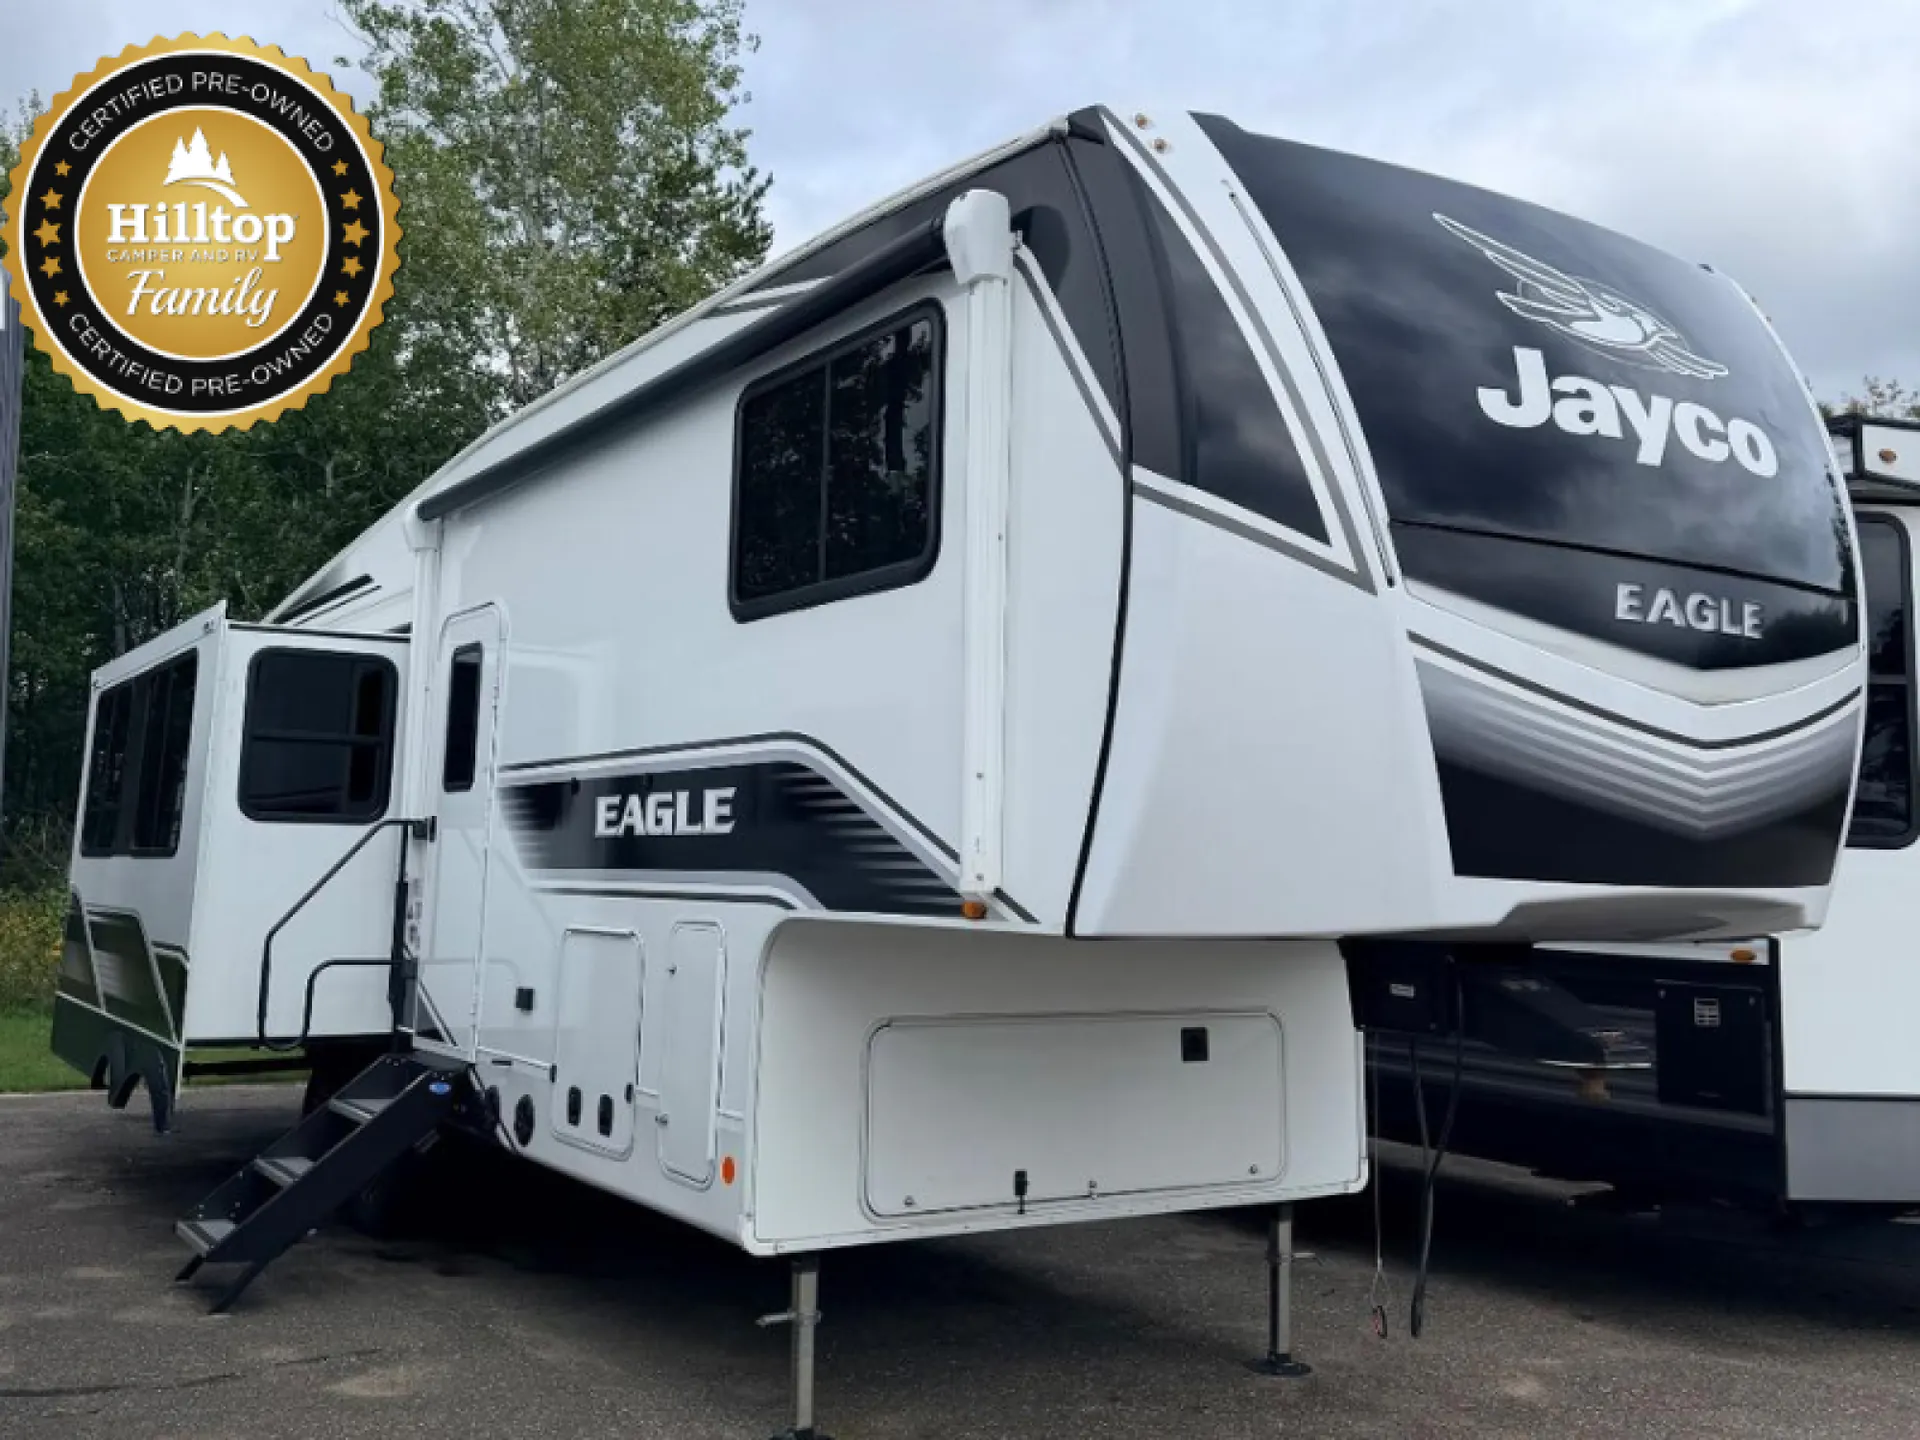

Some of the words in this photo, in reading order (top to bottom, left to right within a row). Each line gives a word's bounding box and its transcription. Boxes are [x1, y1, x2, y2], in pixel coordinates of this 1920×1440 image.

[1477, 346, 1779, 479] Jayco
[1614, 582, 1763, 640] EAGLE
[595, 787, 737, 838] EAGLE
